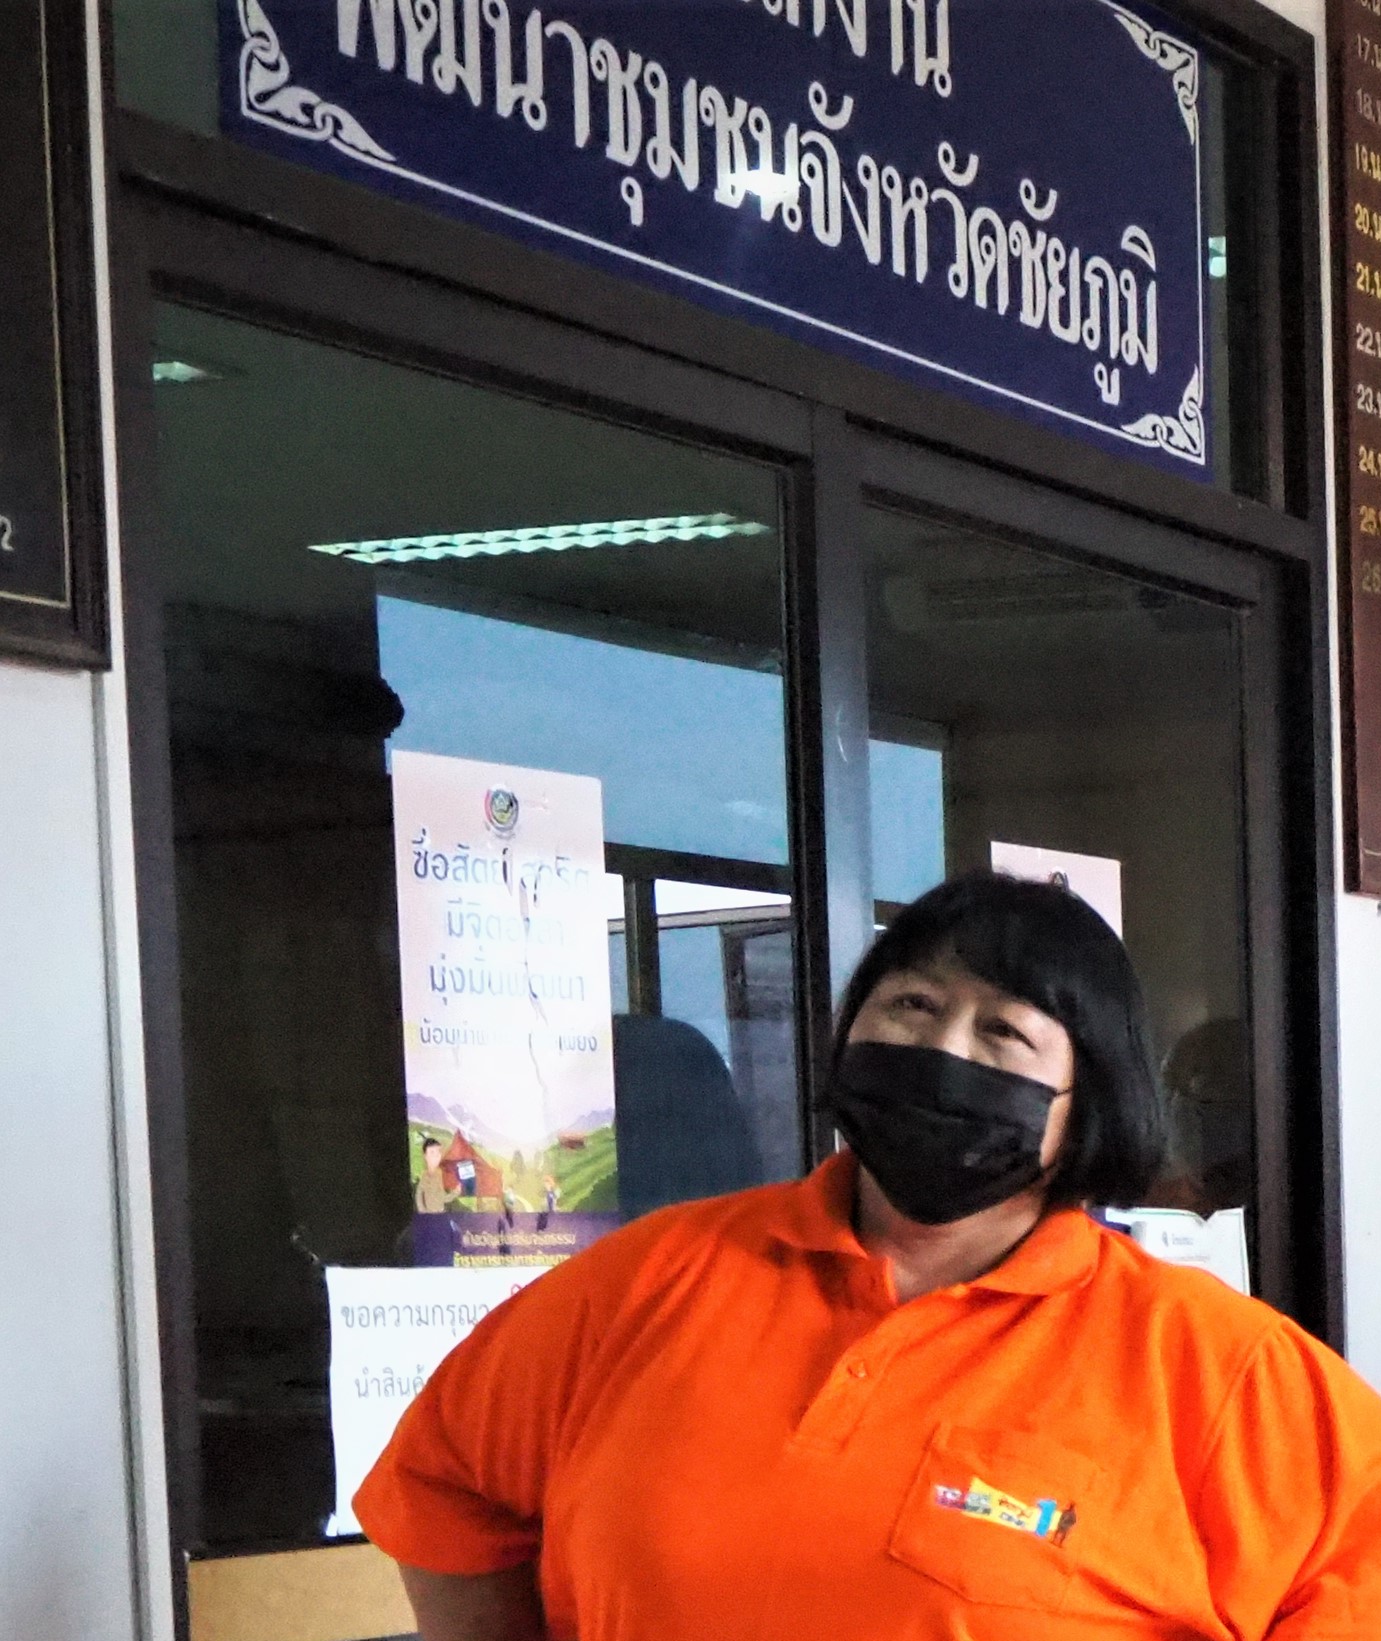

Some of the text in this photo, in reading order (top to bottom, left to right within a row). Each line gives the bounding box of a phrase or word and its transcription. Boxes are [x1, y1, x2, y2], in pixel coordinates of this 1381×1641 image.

[337, 0, 1158, 404] พฒนาชุมชนจังหวัดชัยภูมิ
